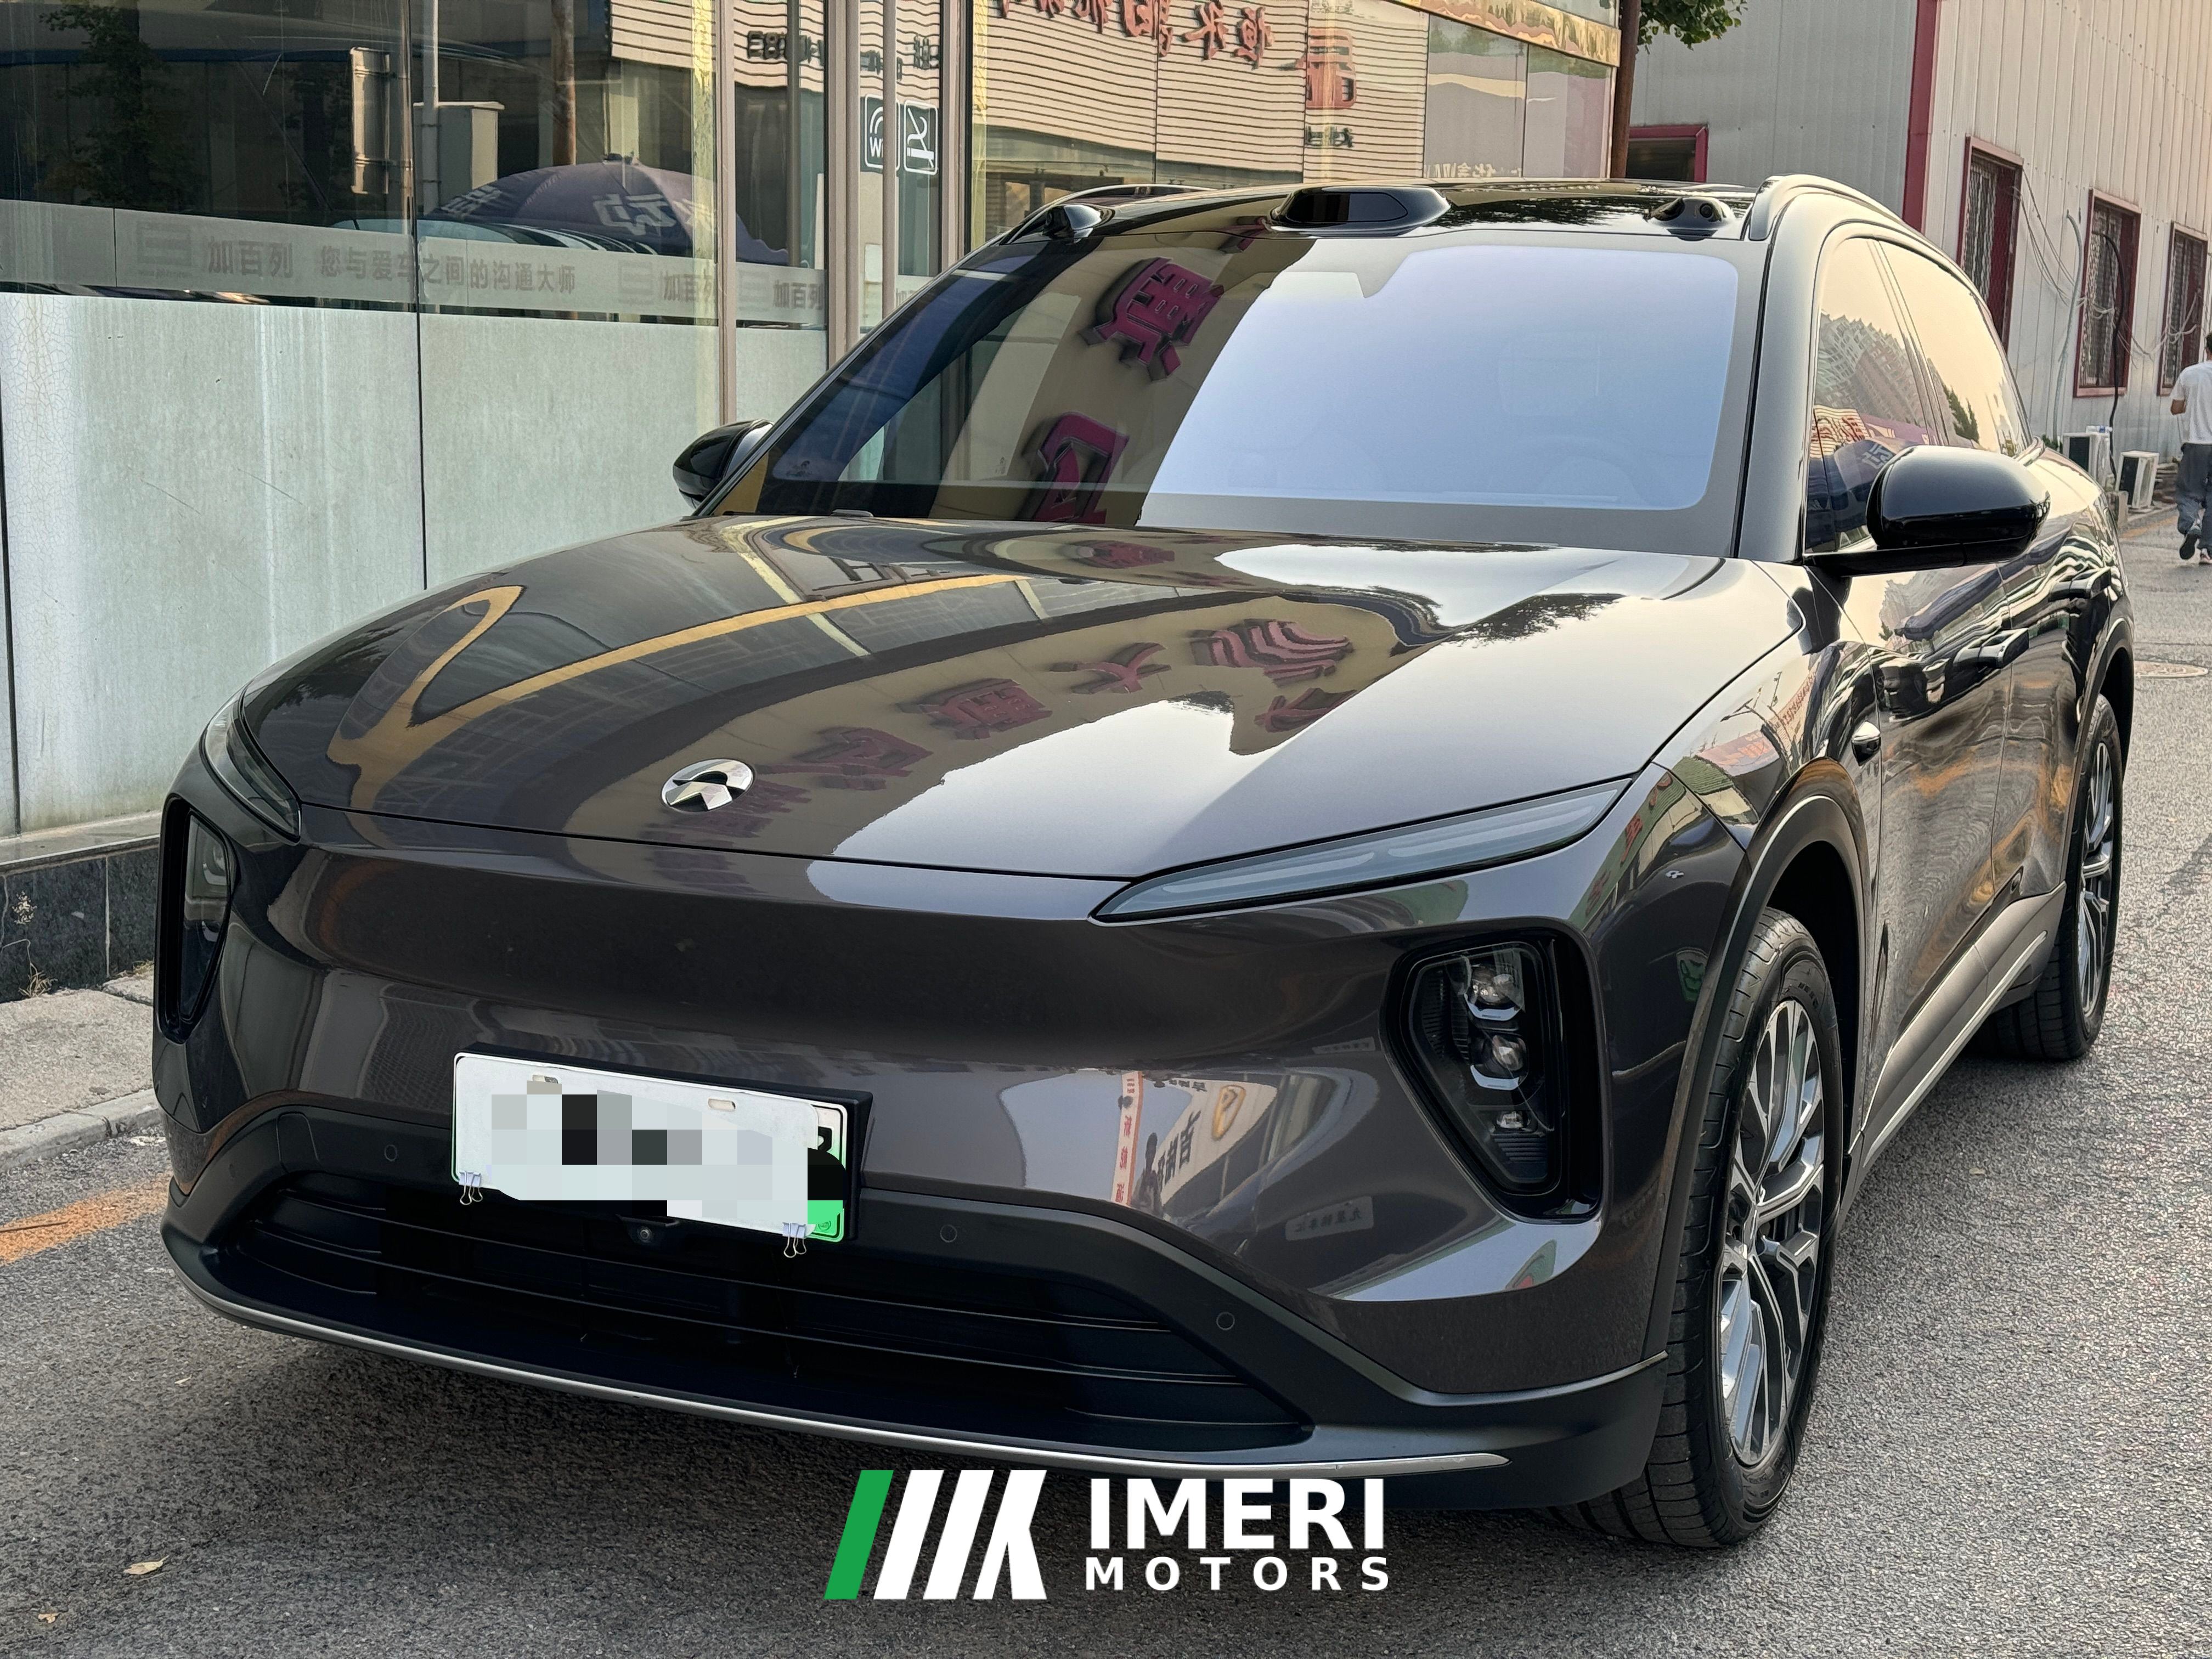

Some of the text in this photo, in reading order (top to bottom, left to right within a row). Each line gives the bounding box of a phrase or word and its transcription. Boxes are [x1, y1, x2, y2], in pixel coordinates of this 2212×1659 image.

[208, 236, 575, 295] 加百列 您与爱车之间的沟通大师
